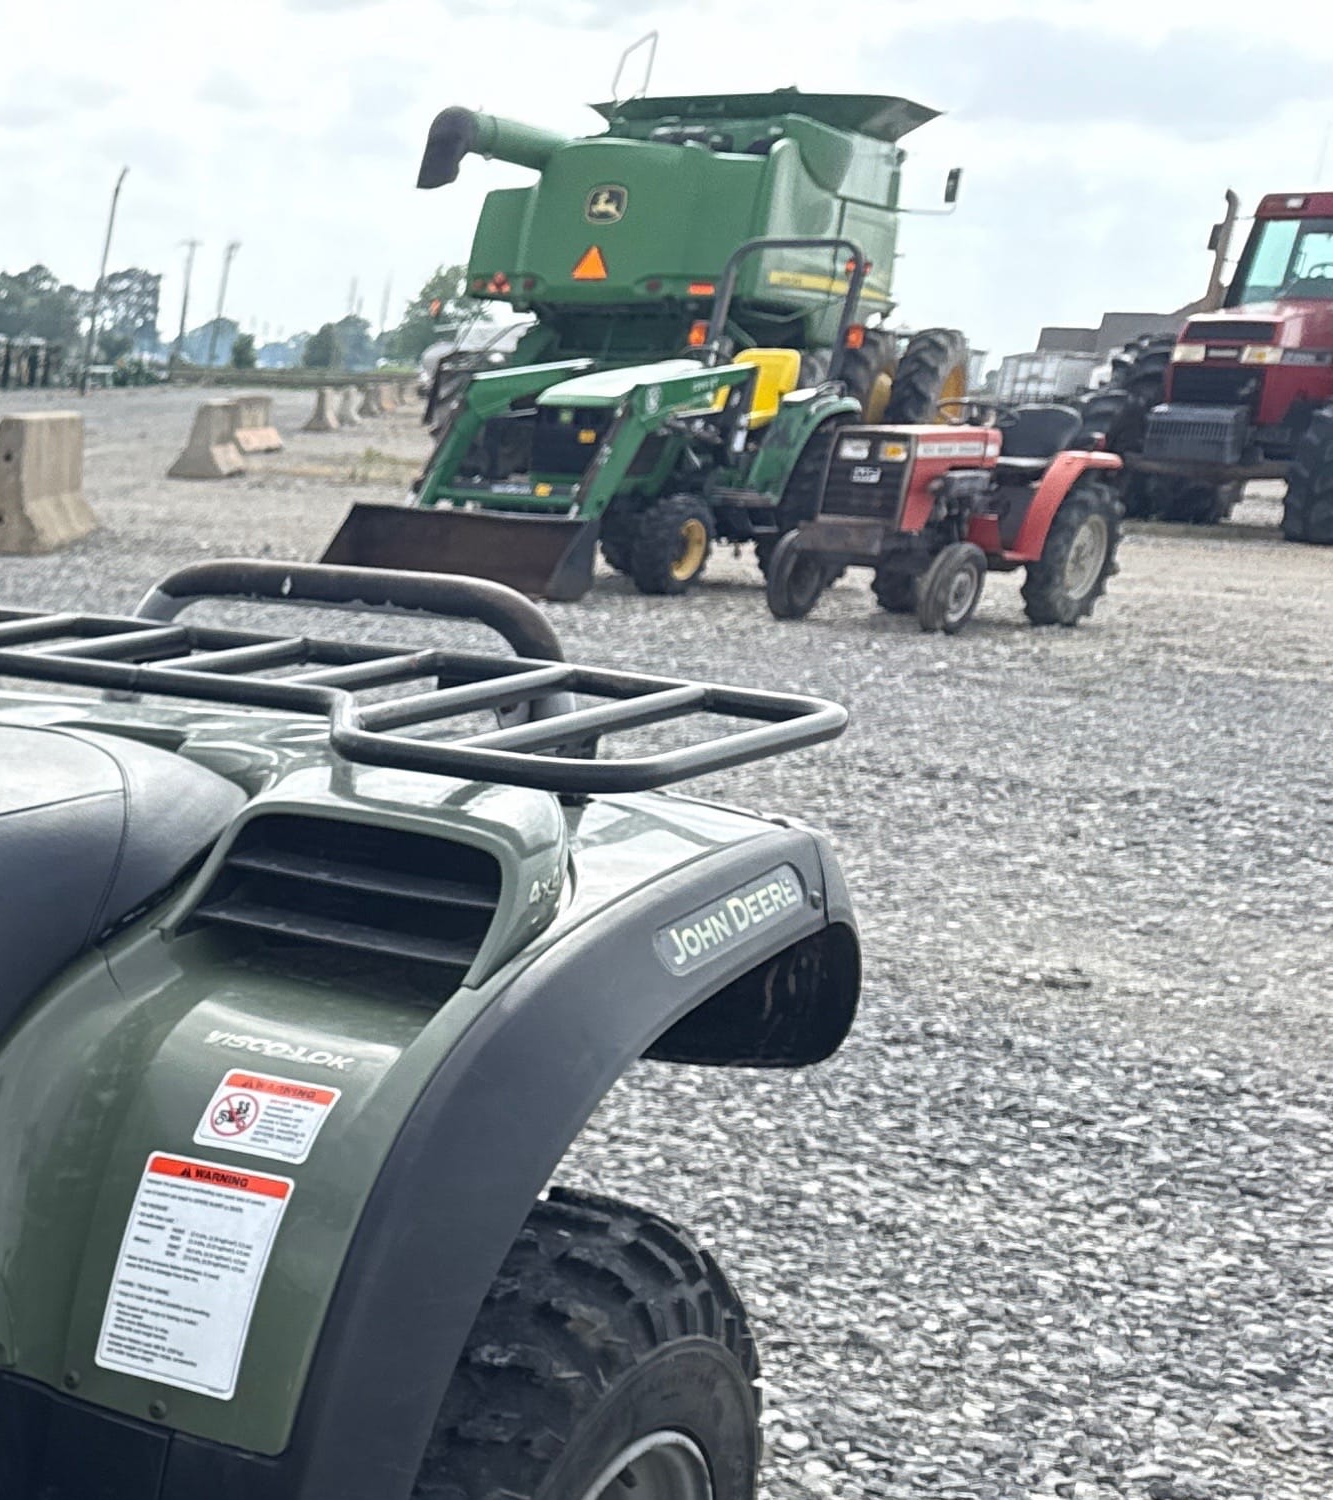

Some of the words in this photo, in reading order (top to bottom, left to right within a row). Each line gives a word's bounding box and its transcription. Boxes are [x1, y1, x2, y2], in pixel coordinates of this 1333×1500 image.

[669, 910, 733, 965] JOHN
[726, 879, 797, 932] DEERE
[195, 1168, 249, 1188] WARNING
